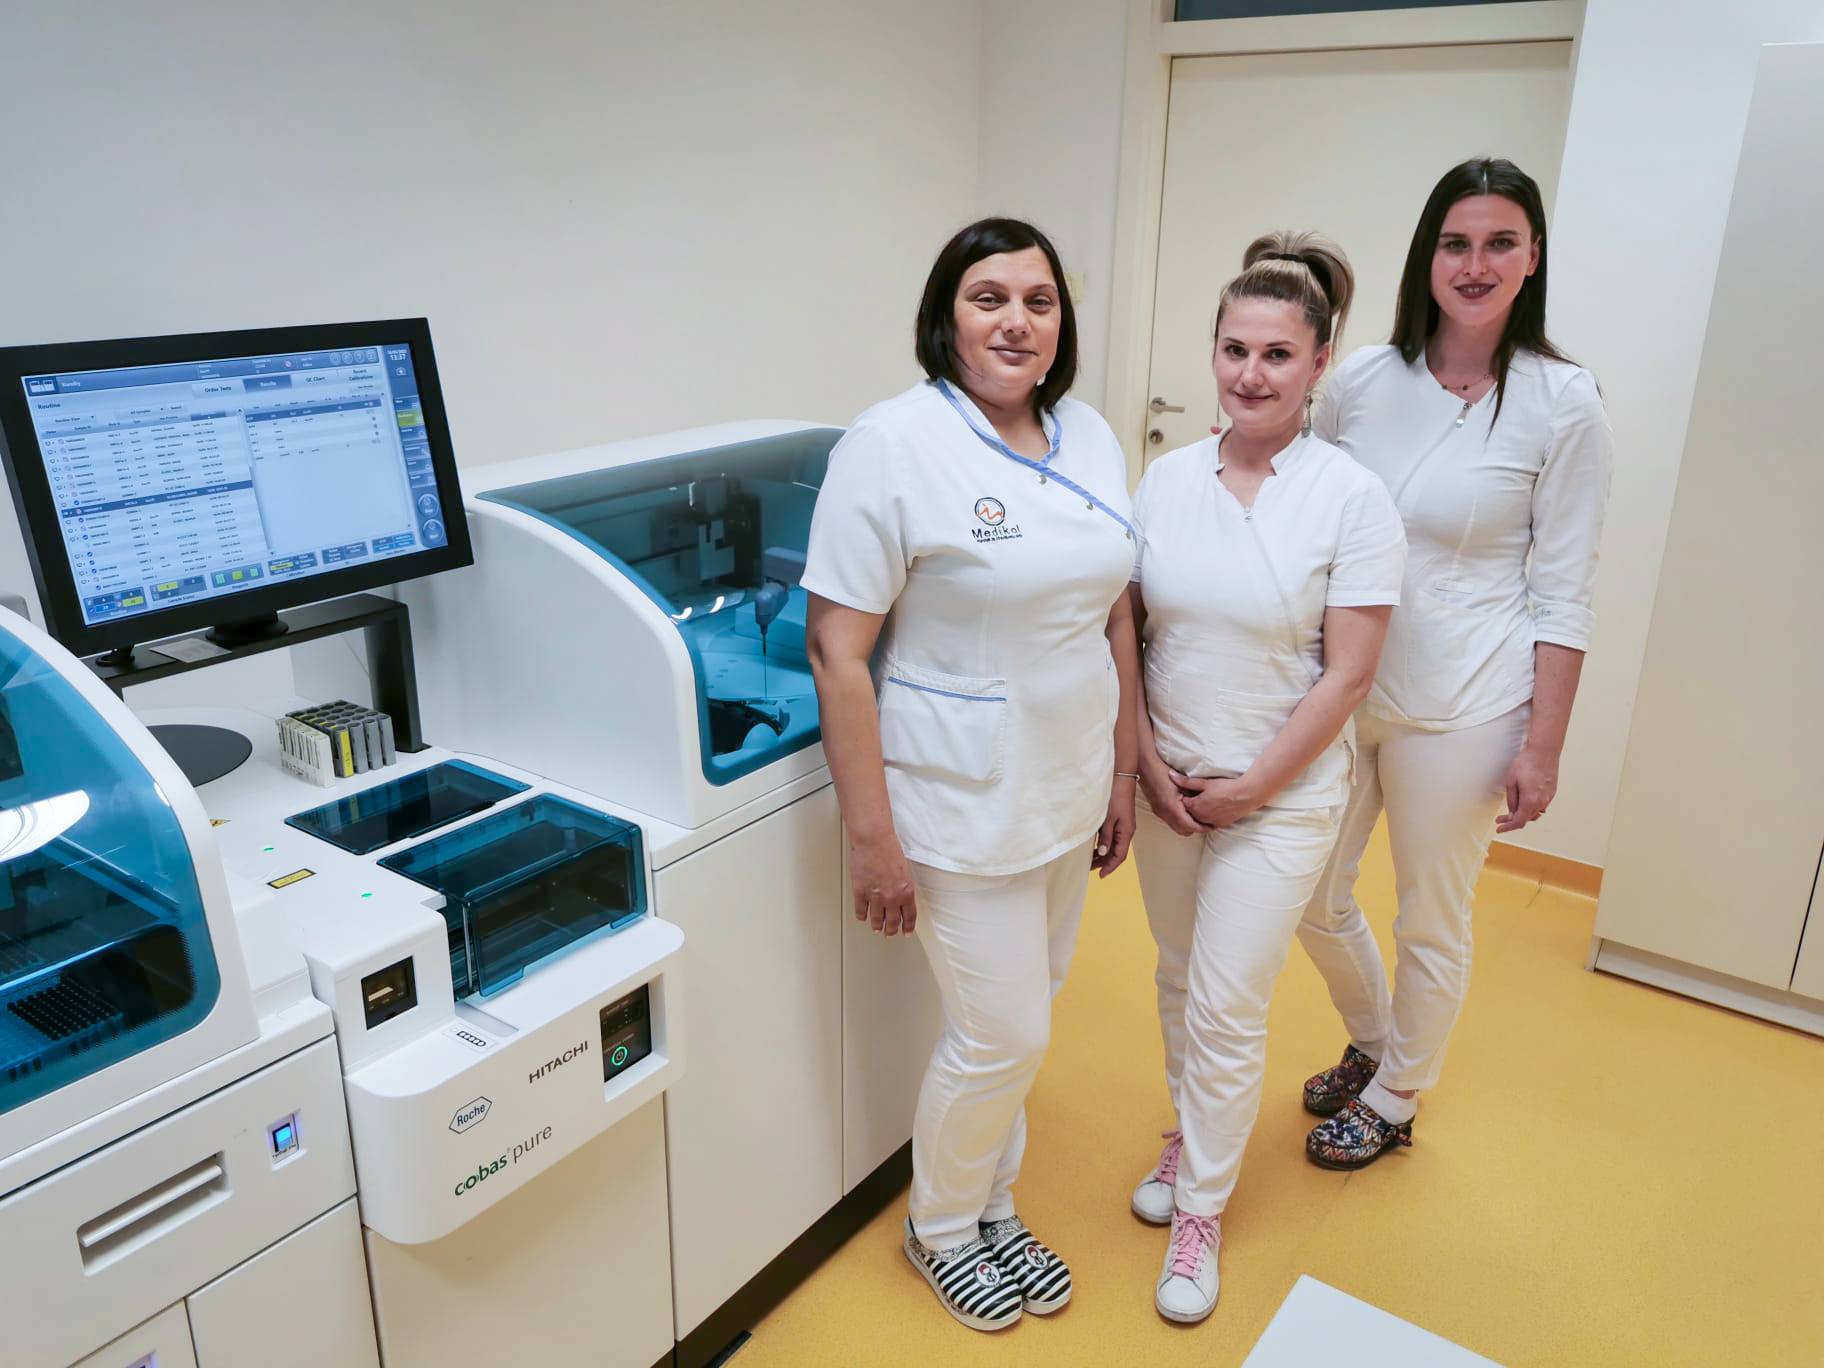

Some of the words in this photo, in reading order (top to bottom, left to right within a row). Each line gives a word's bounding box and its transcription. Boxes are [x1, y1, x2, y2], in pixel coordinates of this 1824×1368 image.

[971, 524, 1021, 539] Medikol
[528, 1040, 589, 1084] HITACHI
[456, 1103, 486, 1127] Roche
[454, 1154, 508, 1196] cobas
[513, 1126, 553, 1164] pure
